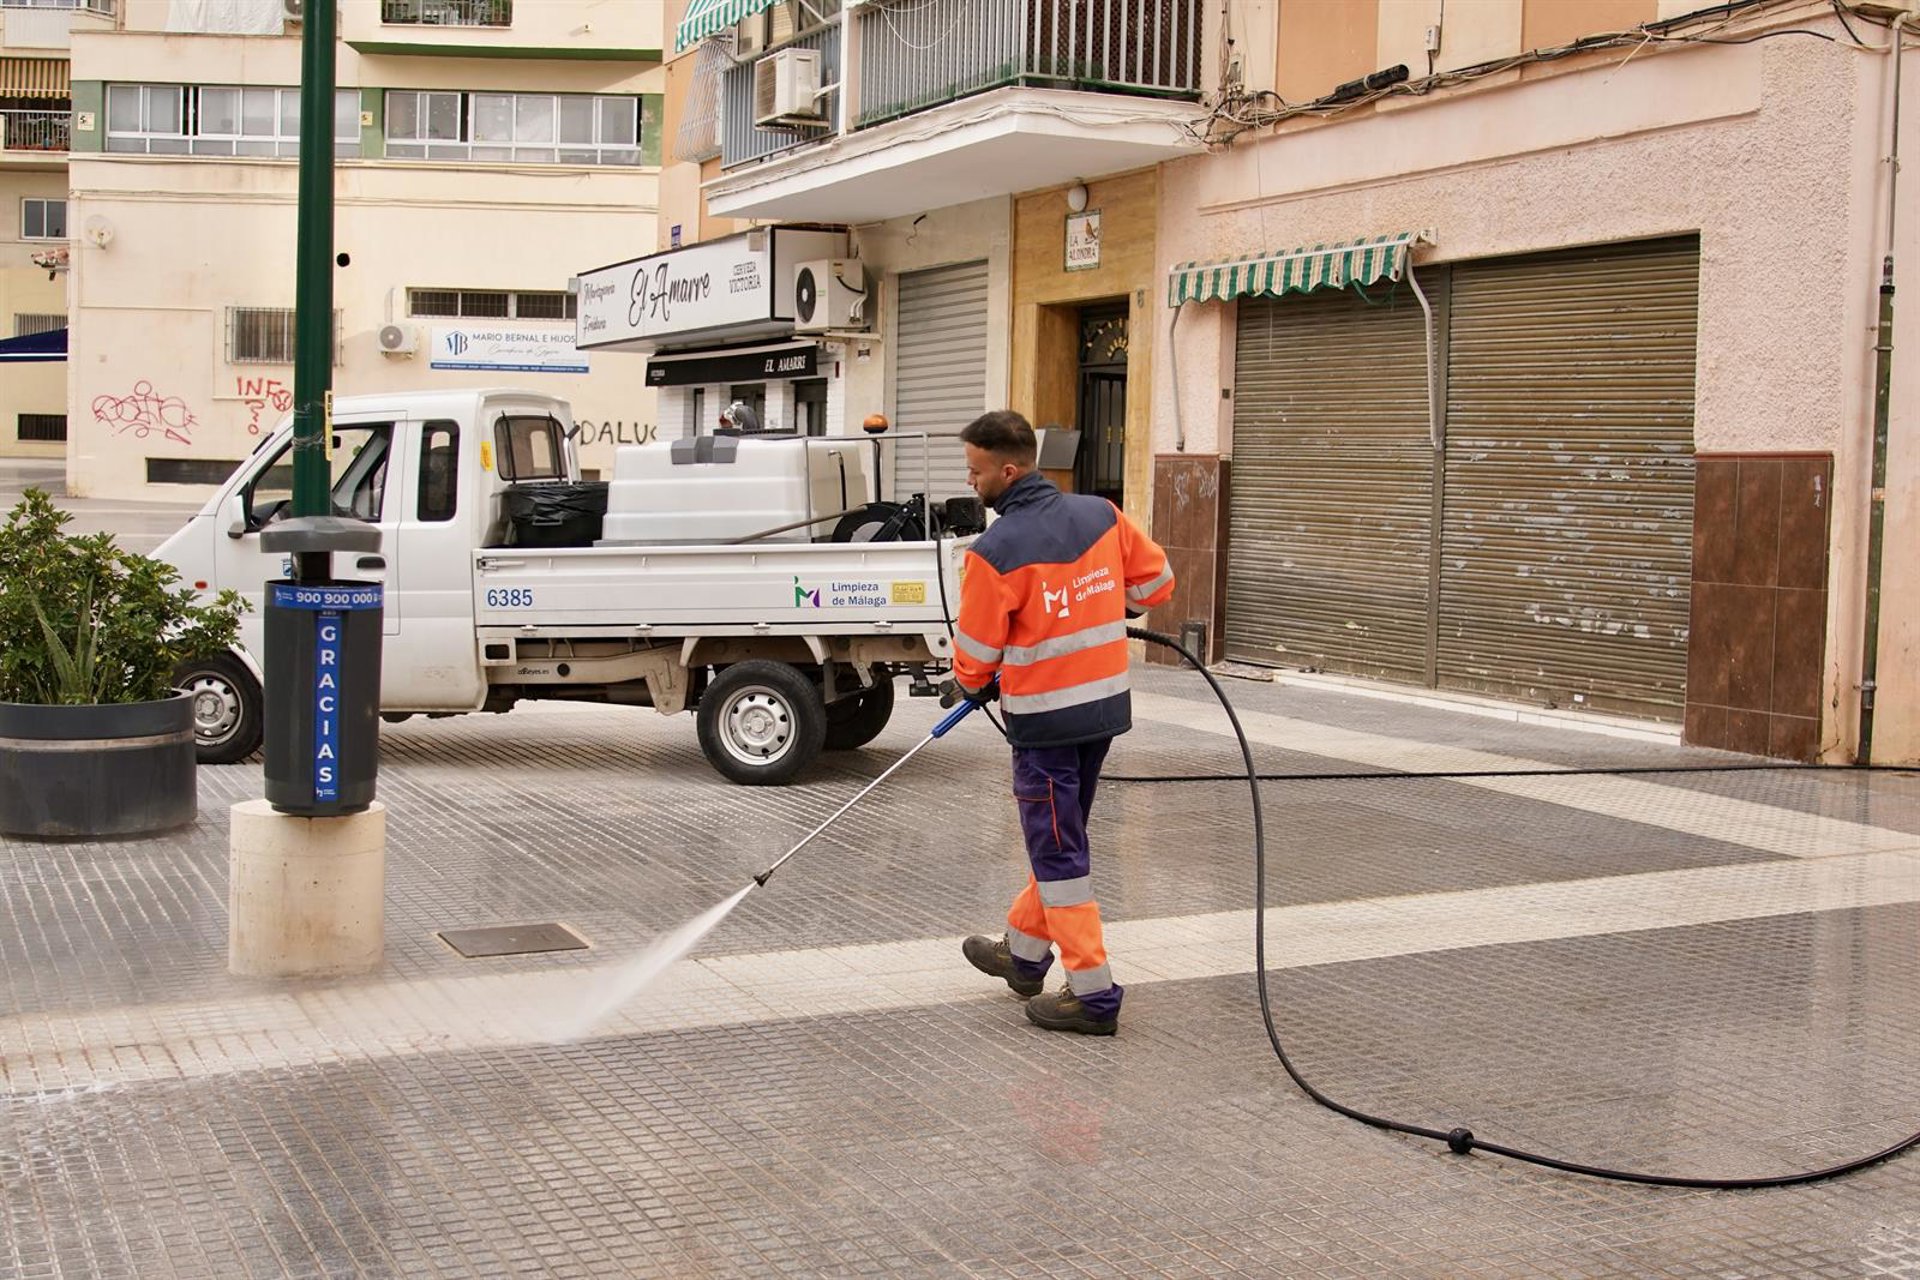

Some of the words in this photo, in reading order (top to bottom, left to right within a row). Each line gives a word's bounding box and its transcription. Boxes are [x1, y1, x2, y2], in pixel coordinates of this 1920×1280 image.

[1070, 235, 1079, 247] LA
[729, 274, 761, 294] VICTORIA
[628, 268, 649, 327] El
[650, 262, 712, 322] Amarre
[472, 333, 502, 342] MARIO
[505, 333, 540, 343] BERNAL
[542, 334, 547, 343] E
[550, 335, 576, 344] HIJOS
[764, 359, 775, 373] EL
[777, 355, 806, 372] AMARRE
[832, 582, 879, 592] Limpieza
[296, 592, 321, 603] 900
[324, 593, 350, 604] 900
[352, 593, 373, 603] 000
[487, 589, 533, 607] 6385
[832, 595, 845, 606] de
[848, 595, 887, 607] Málaga
[318, 626, 336, 782] GRACIAS
